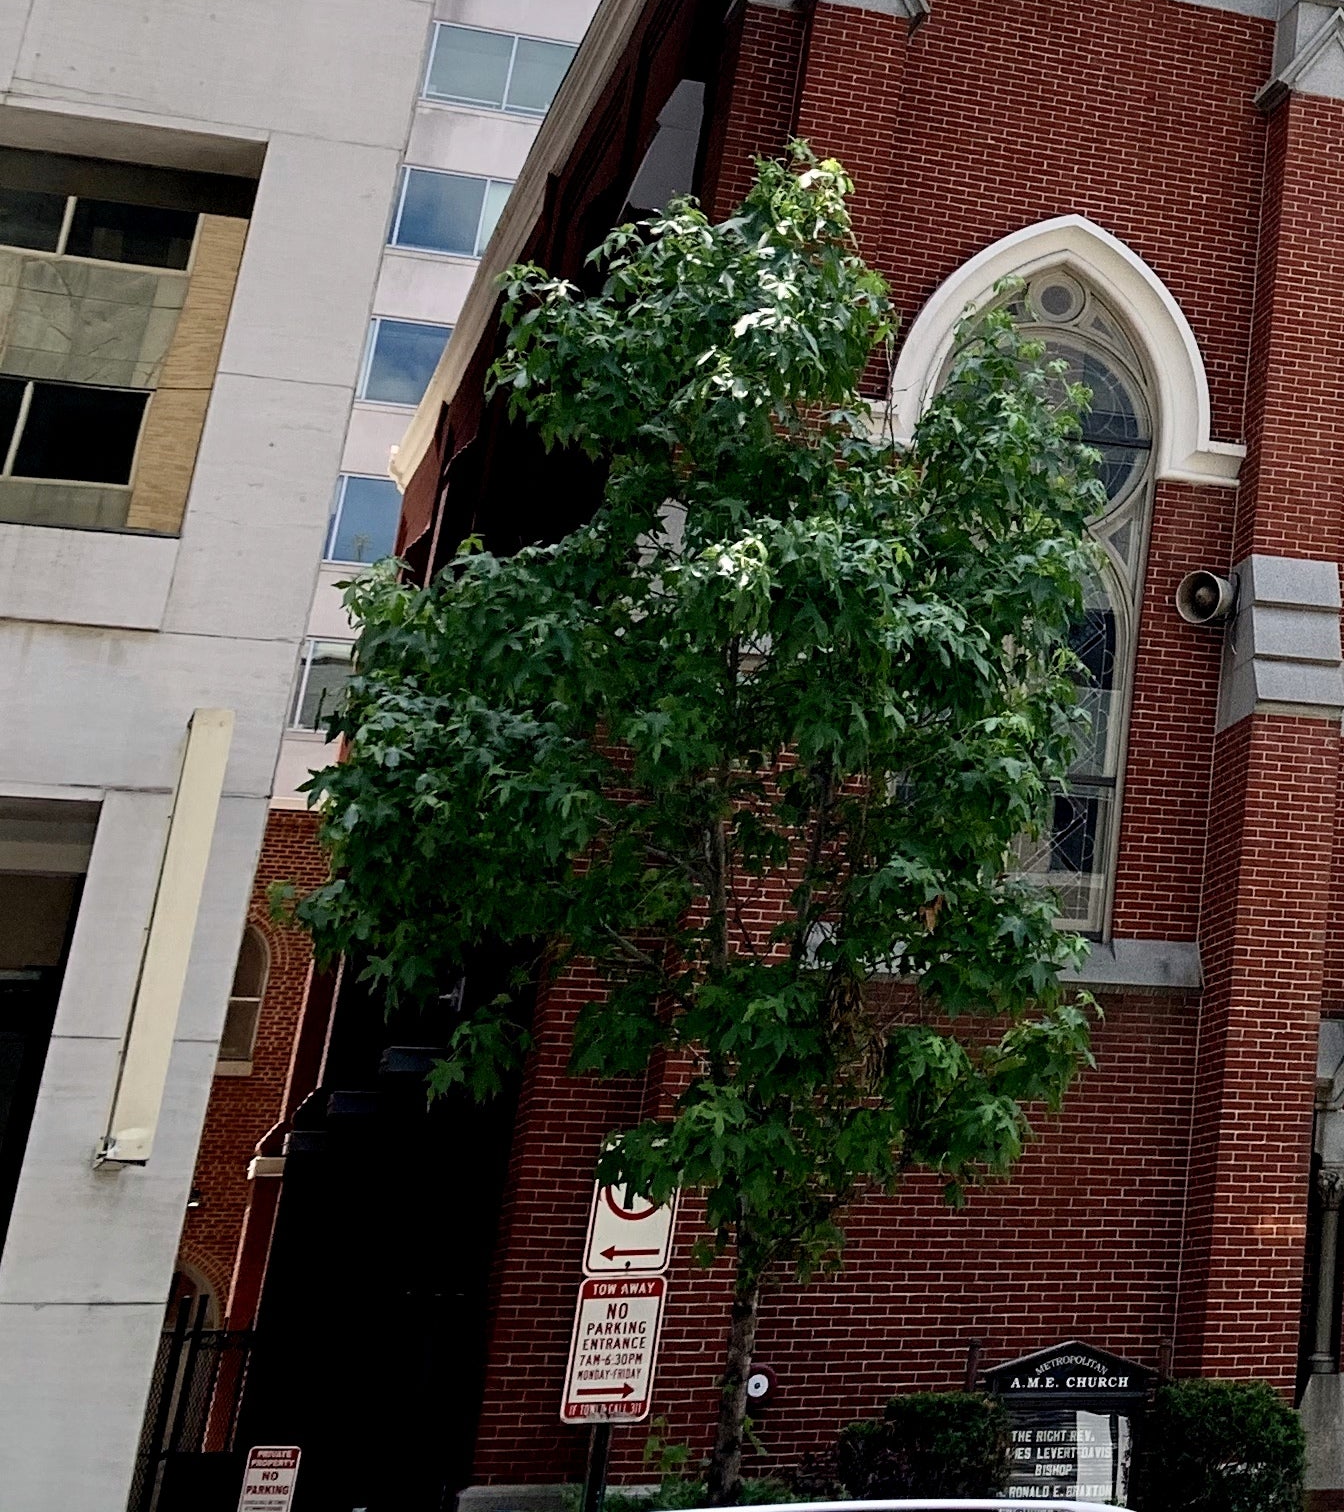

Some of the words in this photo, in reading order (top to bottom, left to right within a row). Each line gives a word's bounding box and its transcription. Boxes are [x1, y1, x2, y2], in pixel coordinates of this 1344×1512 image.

[593, 1284, 617, 1295] TOW
[620, 1282, 655, 1295] AWAY
[606, 1303, 629, 1320] NO
[586, 1321, 647, 1335] PARKING
[582, 1336, 647, 1350] ENTRANCE
[1035, 1355, 1109, 1375] METROPOLITAN
[1010, 1377, 1060, 1388] A.M.E.
[1066, 1376, 1130, 1388] CHURCH
[1011, 1430, 1032, 1442] THE
[1036, 1430, 1067, 1442] RIGHT
[1036, 1447, 1076, 1459] LEVERT
[1080, 1447, 1112, 1459] DAVIS
[251, 1459, 296, 1467] PROPERTY
[261, 1471, 279, 1481] NO
[1035, 1464, 1073, 1476] BISHOP
[246, 1485, 289, 1495] PARKING
[1008, 1486, 1050, 1498] RONALD
